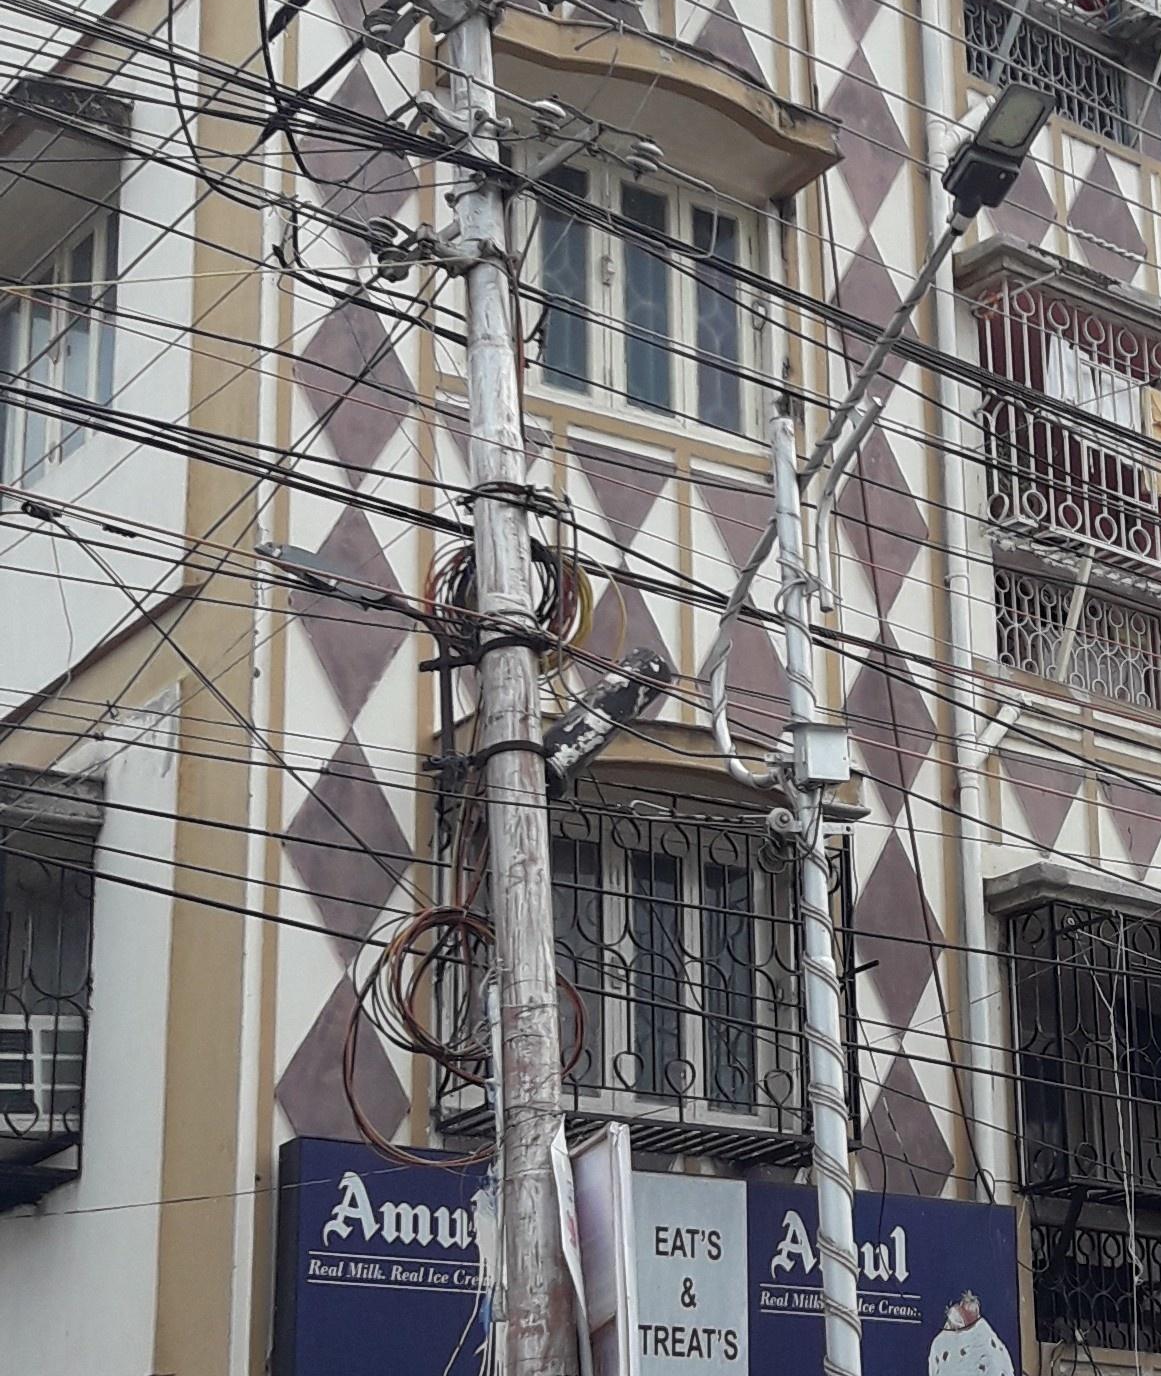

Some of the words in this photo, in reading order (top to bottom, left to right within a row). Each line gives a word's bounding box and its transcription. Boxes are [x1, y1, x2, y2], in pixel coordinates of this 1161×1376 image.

[655, 1226, 722, 1260] EAT'S
[771, 1210, 909, 1283] Aul
[308, 1259, 344, 1277] Real
[391, 1266, 425, 1282] Real
[428, 1268, 449, 1284] Ice
[680, 1277, 696, 1308] &
[760, 1291, 788, 1306] Real
[857, 1299, 875, 1313] Ice
[638, 1324, 738, 1360] TREAT'S
